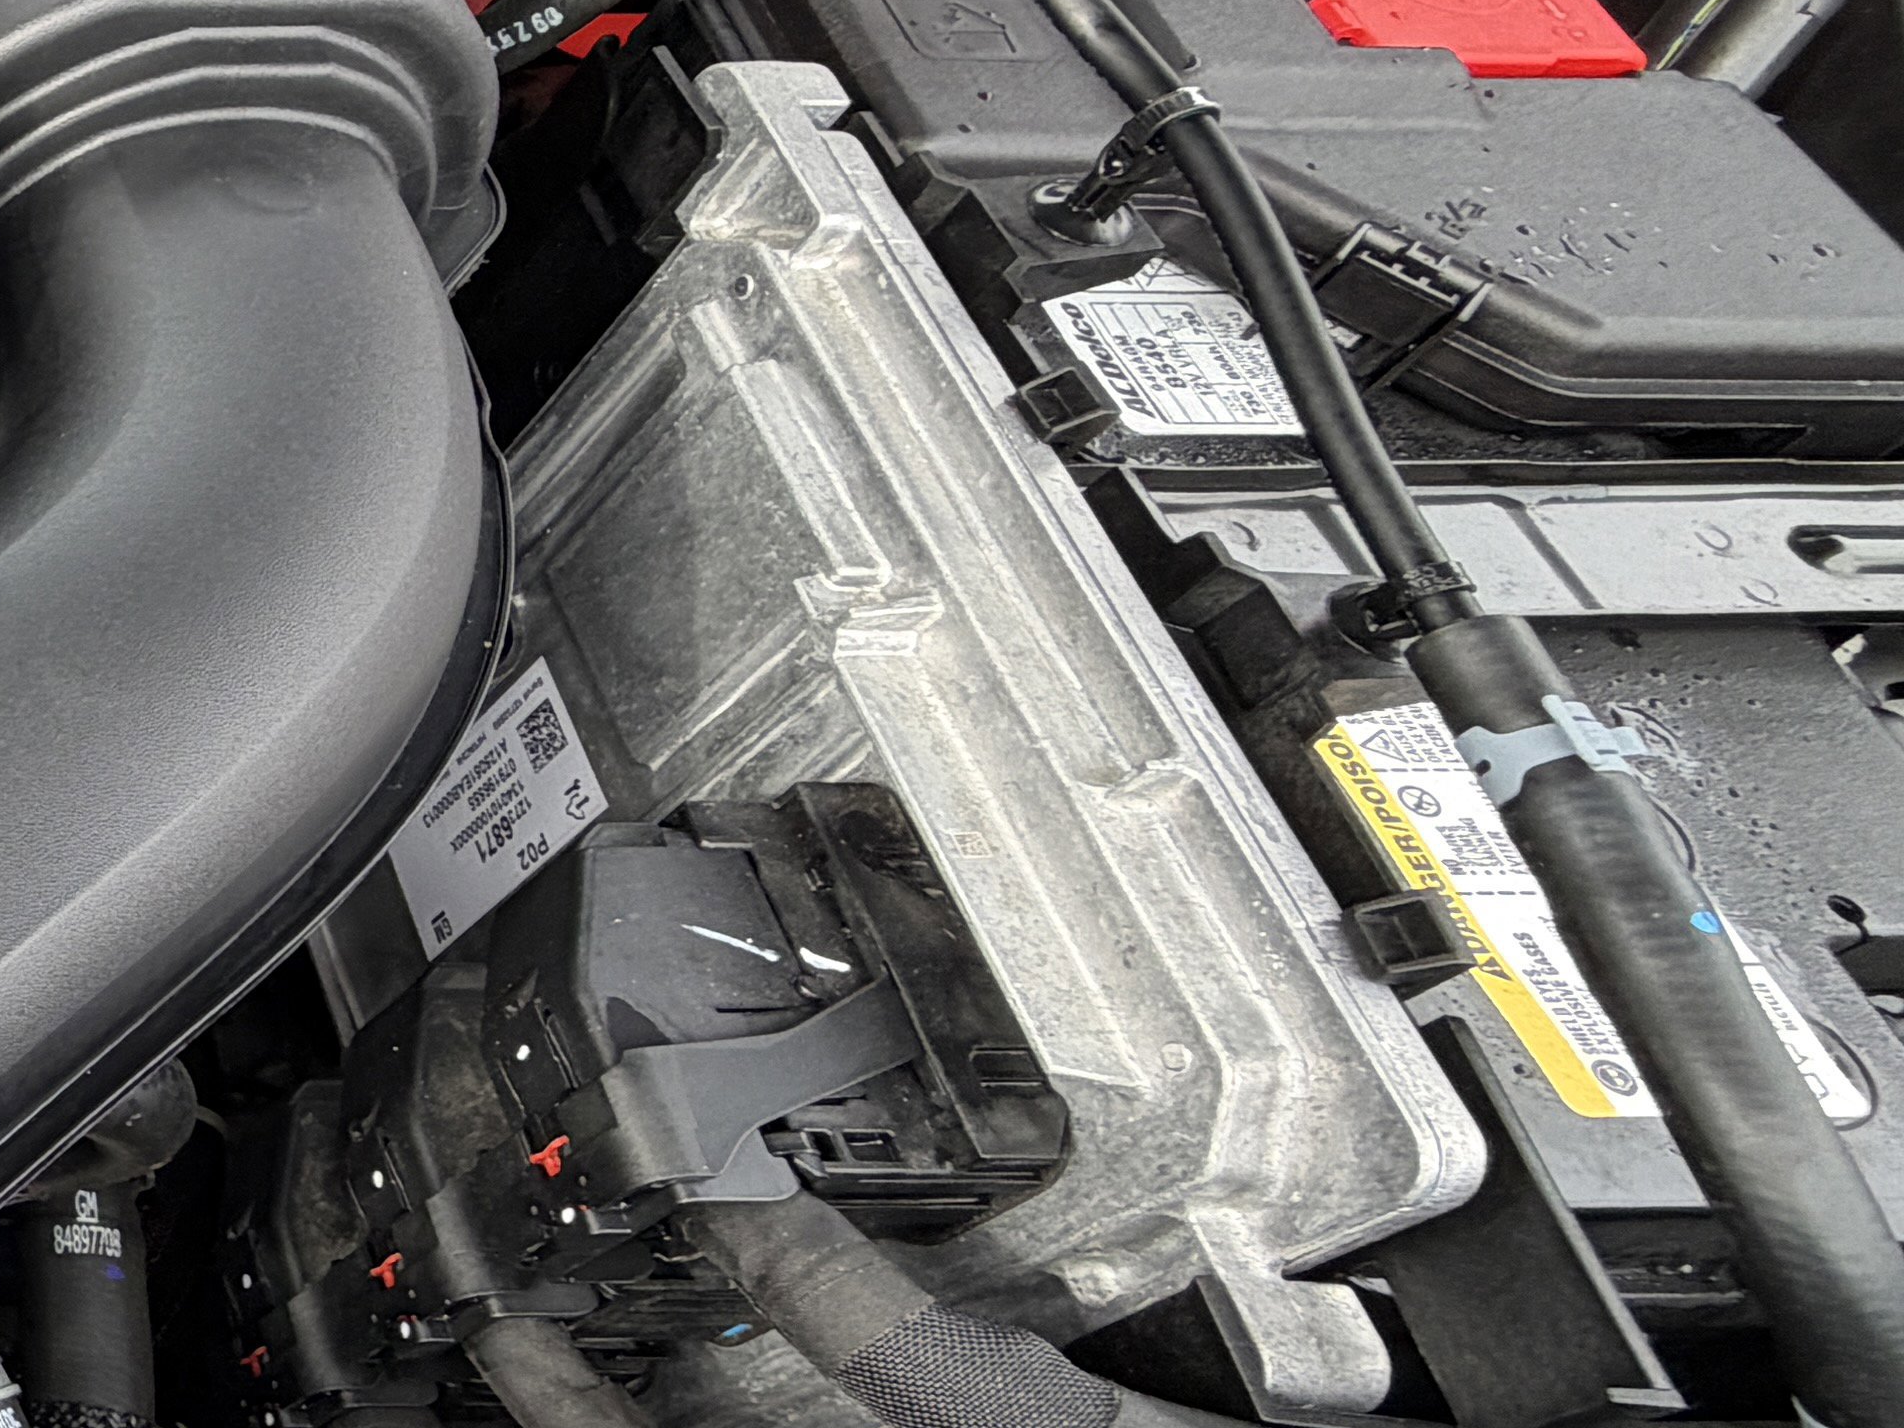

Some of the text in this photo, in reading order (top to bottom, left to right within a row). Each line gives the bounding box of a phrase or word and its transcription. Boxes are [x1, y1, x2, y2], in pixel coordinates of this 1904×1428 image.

[1178, 310, 1209, 335] 730
[1060, 302, 1155, 419] ACDelco
[1136, 337, 1188, 390] 8540
[520, 832, 549, 871] P02
[435, 914, 454, 945] GM
[1512, 931, 1556, 975] GASES
[1550, 979, 1619, 1055] EXPLOSIVE
[1551, 1007, 1601, 1055] SHIELD
[76, 1190, 98, 1220] GM
